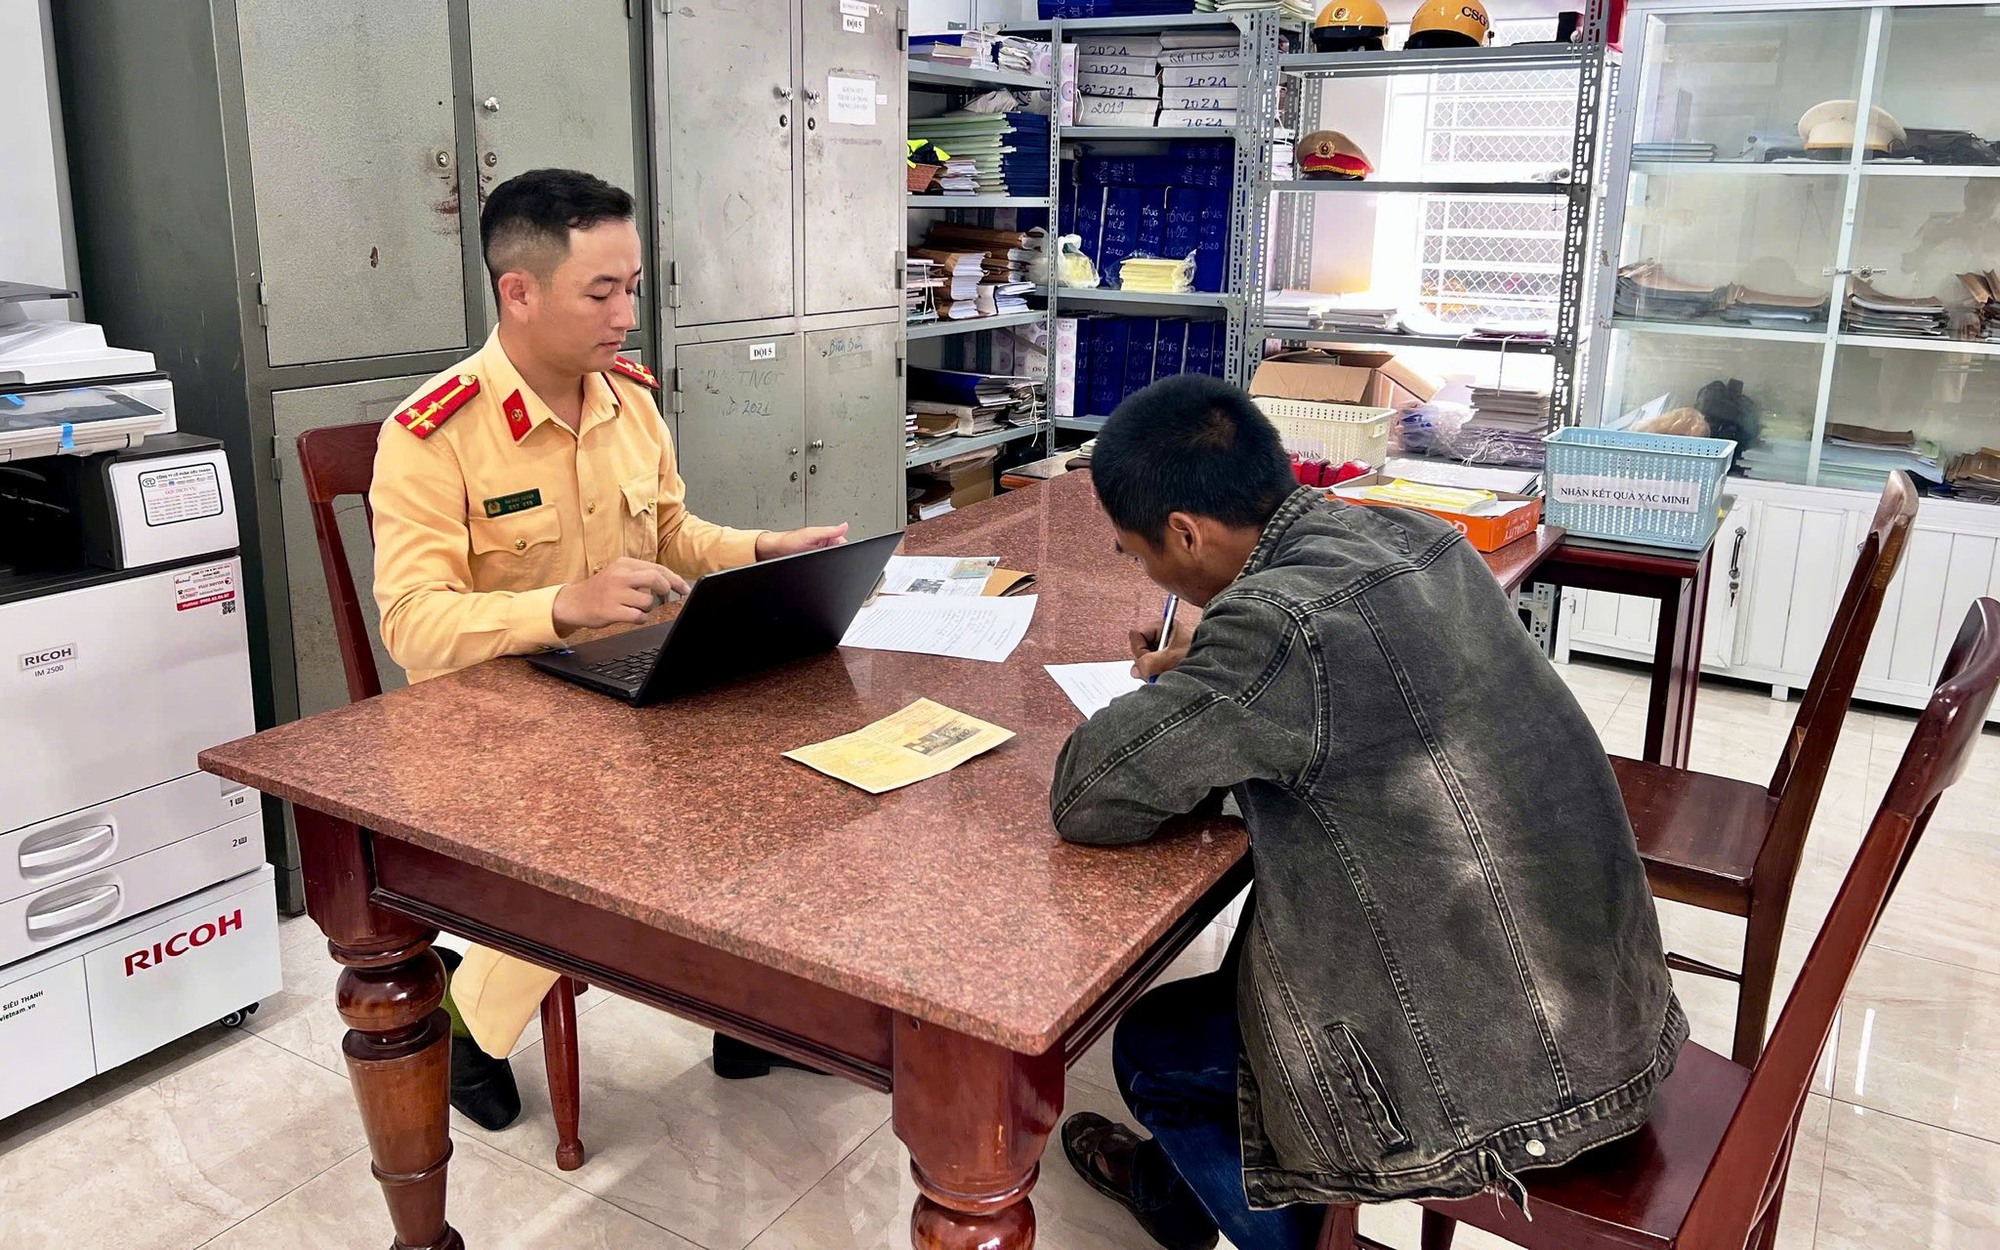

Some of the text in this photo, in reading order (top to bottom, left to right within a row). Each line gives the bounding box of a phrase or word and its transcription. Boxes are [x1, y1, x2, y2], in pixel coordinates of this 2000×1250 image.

[1560, 487, 1590, 498] NHẬN
[1591, 487, 1611, 499] KẾT
[1613, 490, 1636, 501] QUẢ
[1661, 495, 1690, 505] MINH
[24, 647, 72, 666] RICOH
[34, 664, 64, 677] IM 2500
[229, 799, 233, 807] 1
[232, 839, 238, 847] 2
[124, 908, 243, 977] RICOH
[20, 990, 44, 1003] THANH
